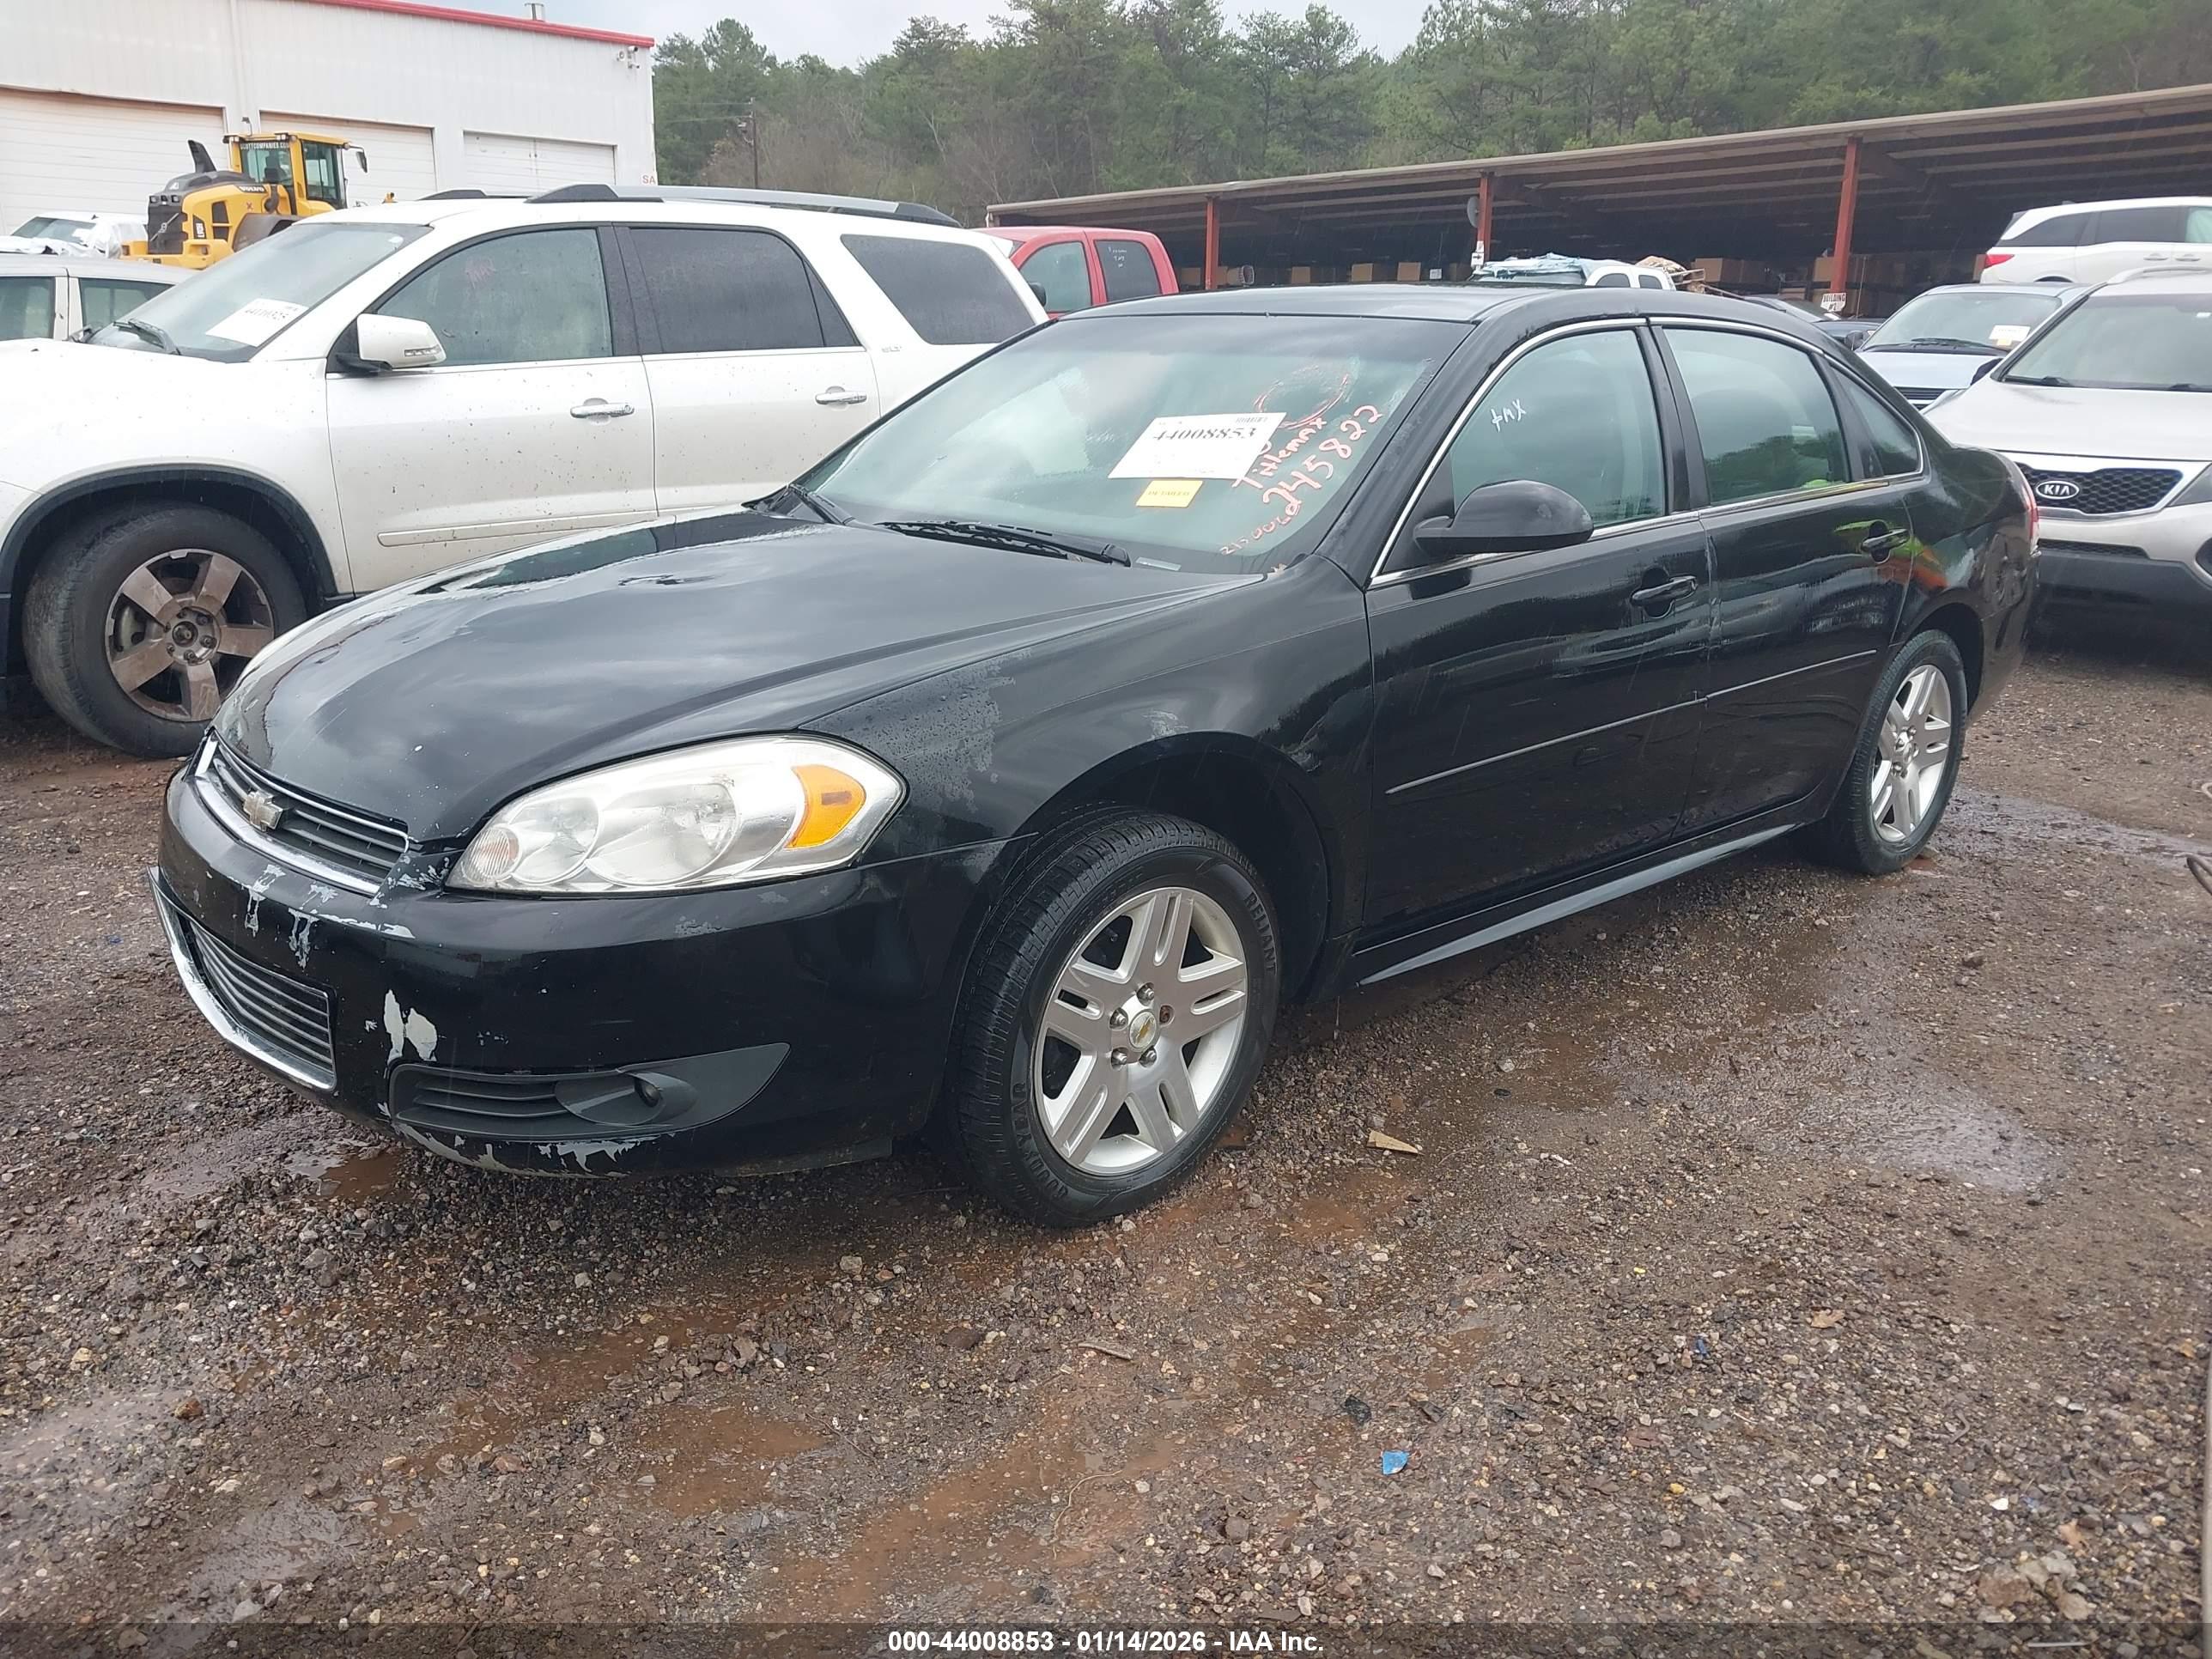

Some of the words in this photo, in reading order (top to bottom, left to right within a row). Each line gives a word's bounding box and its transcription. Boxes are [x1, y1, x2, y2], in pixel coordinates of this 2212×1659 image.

[1153, 427, 1257, 441] 44008853
[2044, 484, 2070, 495] KIA
[1244, 890, 1278, 976] RELIANT
